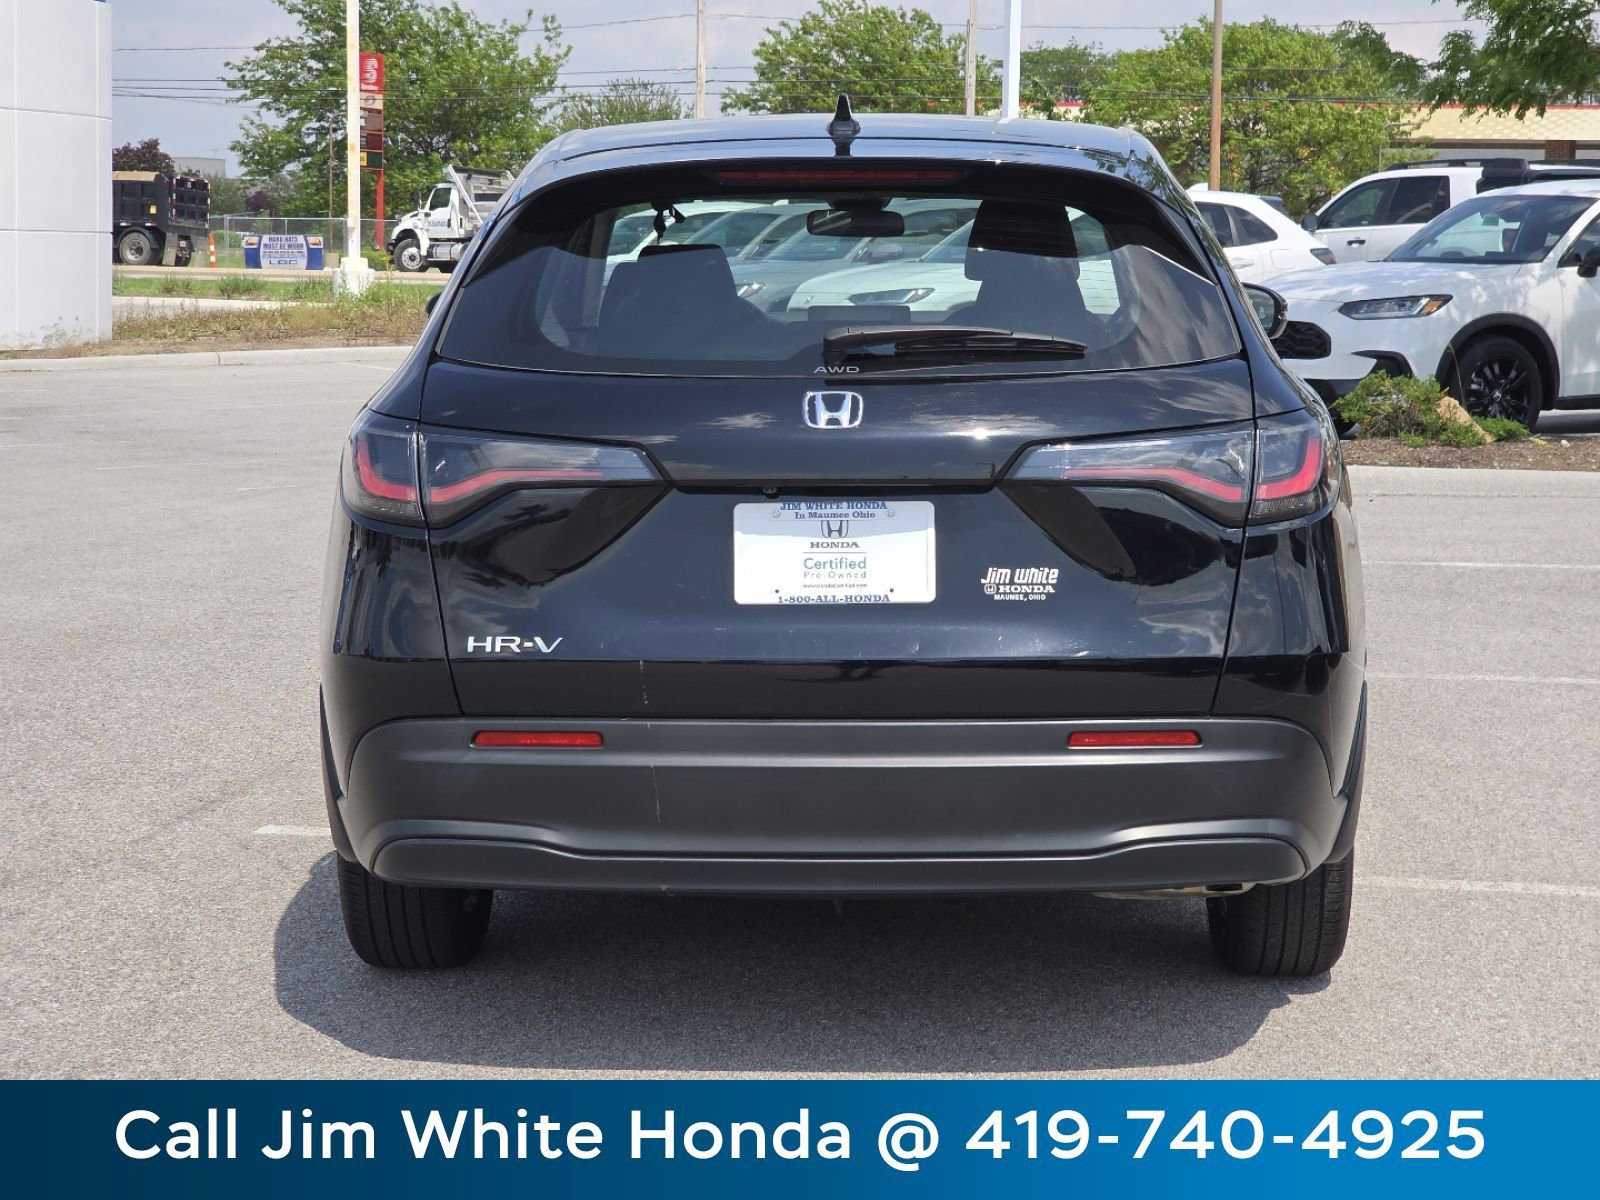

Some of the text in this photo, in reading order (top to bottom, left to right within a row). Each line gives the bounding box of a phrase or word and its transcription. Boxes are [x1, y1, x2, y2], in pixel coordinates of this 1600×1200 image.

[780, 501, 888, 511] JIM WHITE HONDA
[794, 510, 876, 519] In Maumee Ohio
[810, 541, 860, 549] HONDA
[803, 556, 867, 570] Certified
[803, 571, 867, 579] Pre-Owned
[980, 567, 1011, 584] Jim
[998, 585, 1056, 593] HONDA
[778, 594, 891, 604] 1-800-ALL-HONDA
[467, 635, 564, 653] HR-V
